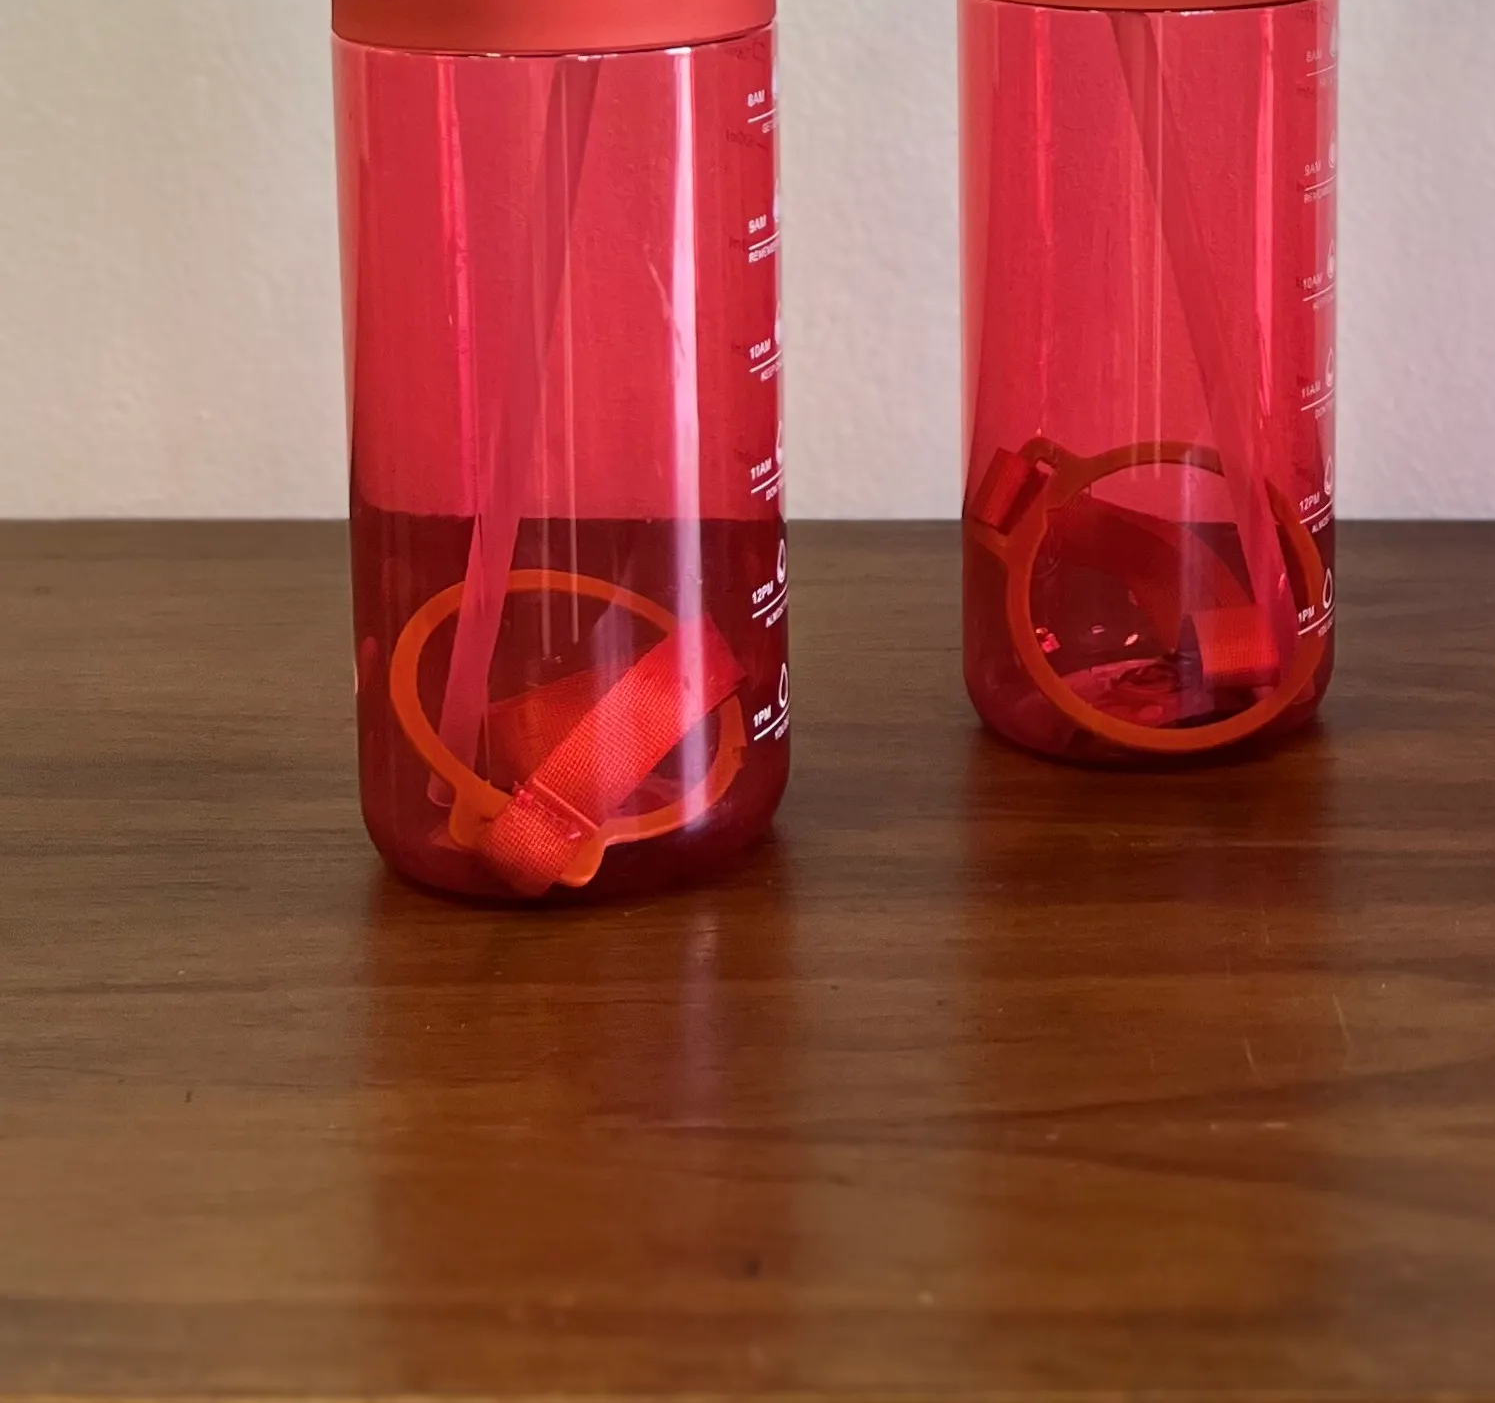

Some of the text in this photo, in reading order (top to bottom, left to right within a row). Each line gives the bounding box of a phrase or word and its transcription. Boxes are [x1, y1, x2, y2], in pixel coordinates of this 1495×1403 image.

[748, 214, 767, 235] 9AM
[749, 338, 772, 361] 10AM
[750, 457, 773, 481] 11AM
[1299, 491, 1321, 512] 12PM
[751, 579, 774, 606] 12PM
[1297, 604, 1316, 625] 1PM
[753, 704, 772, 729] 1PM
